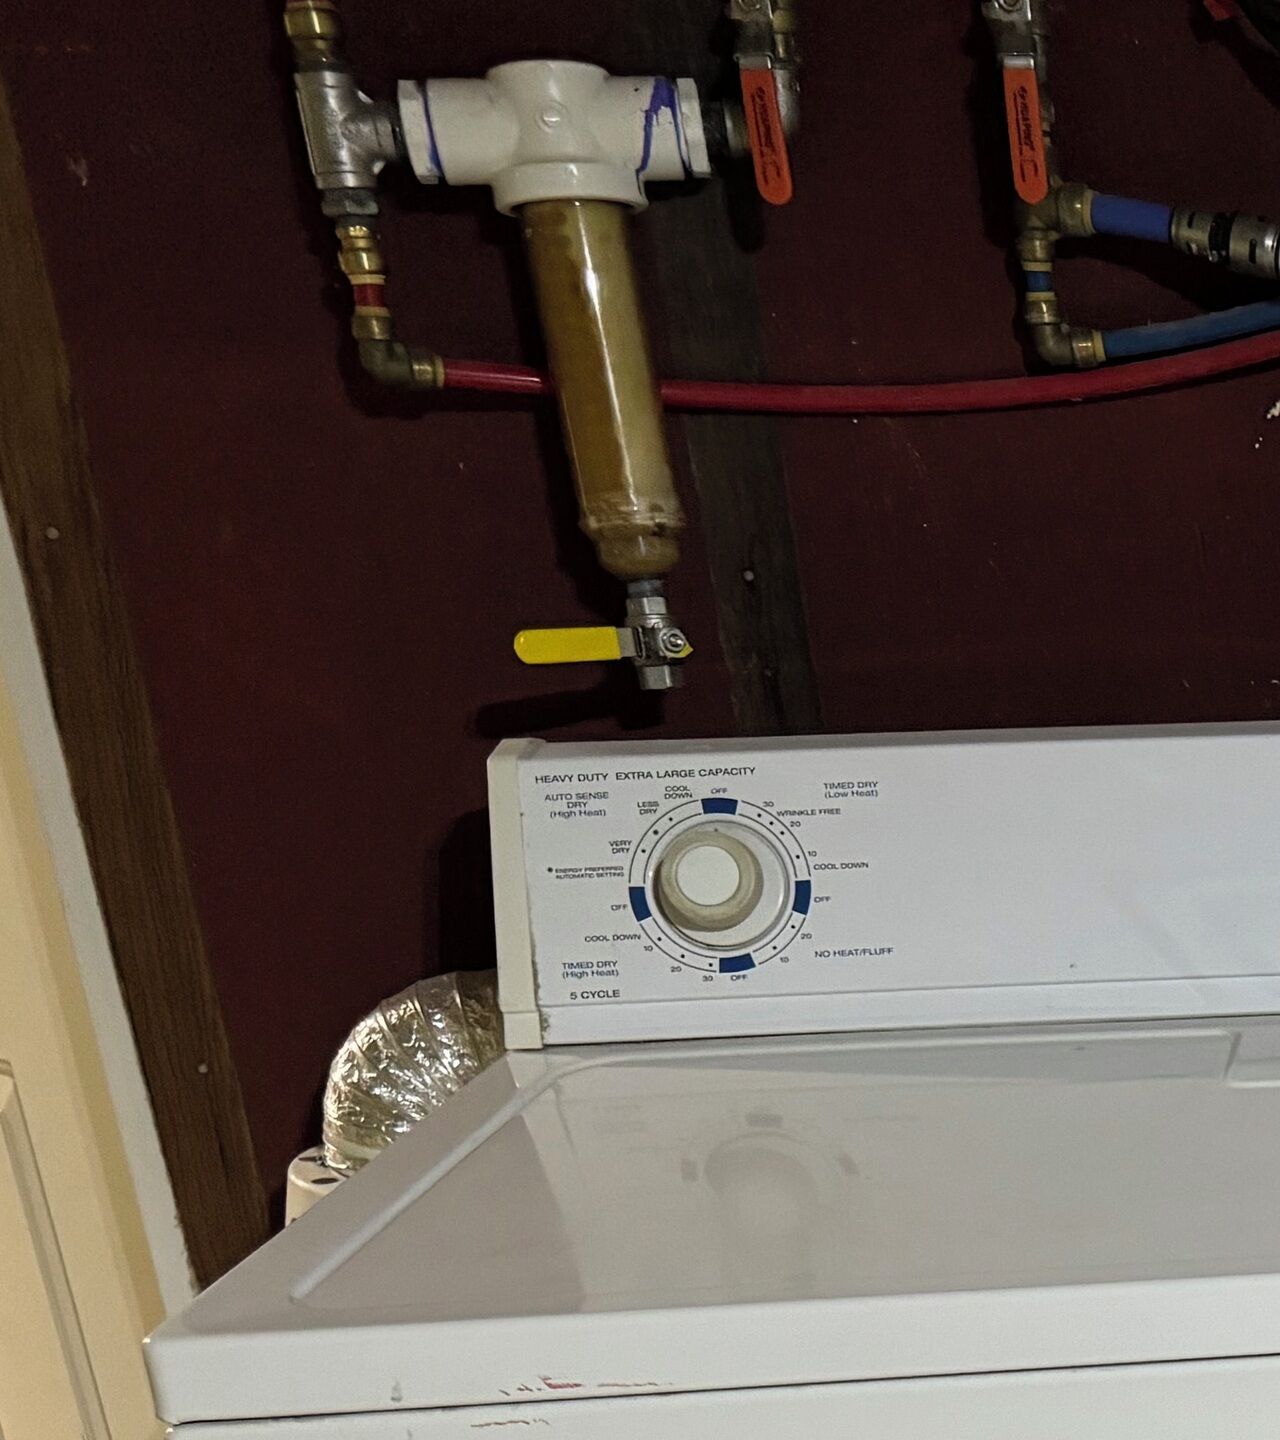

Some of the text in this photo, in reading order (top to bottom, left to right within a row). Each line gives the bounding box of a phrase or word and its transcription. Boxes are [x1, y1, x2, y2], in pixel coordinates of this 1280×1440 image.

[535, 767, 756, 784] HEAVY DUTY EXTRA LARGE CAPACITY
[824, 780, 879, 790] TIMED DRY
[545, 791, 609, 801] AUTO SENSE
[664, 792, 693, 800] DOWN
[710, 787, 728, 795] OFF
[824, 789, 879, 799] (Low Heat)
[566, 801, 588, 809] DRY
[550, 809, 606, 819] (High Heat)
[776, 808, 842, 817] WRINKLE FREE
[814, 896, 832, 904] OFF
[814, 947, 894, 958] NO HEAT/FLUFF
[562, 960, 618, 970] TIMED DRY
[562, 969, 619, 980] (High Heat)
[570, 990, 621, 1000] 5 CYCLE
